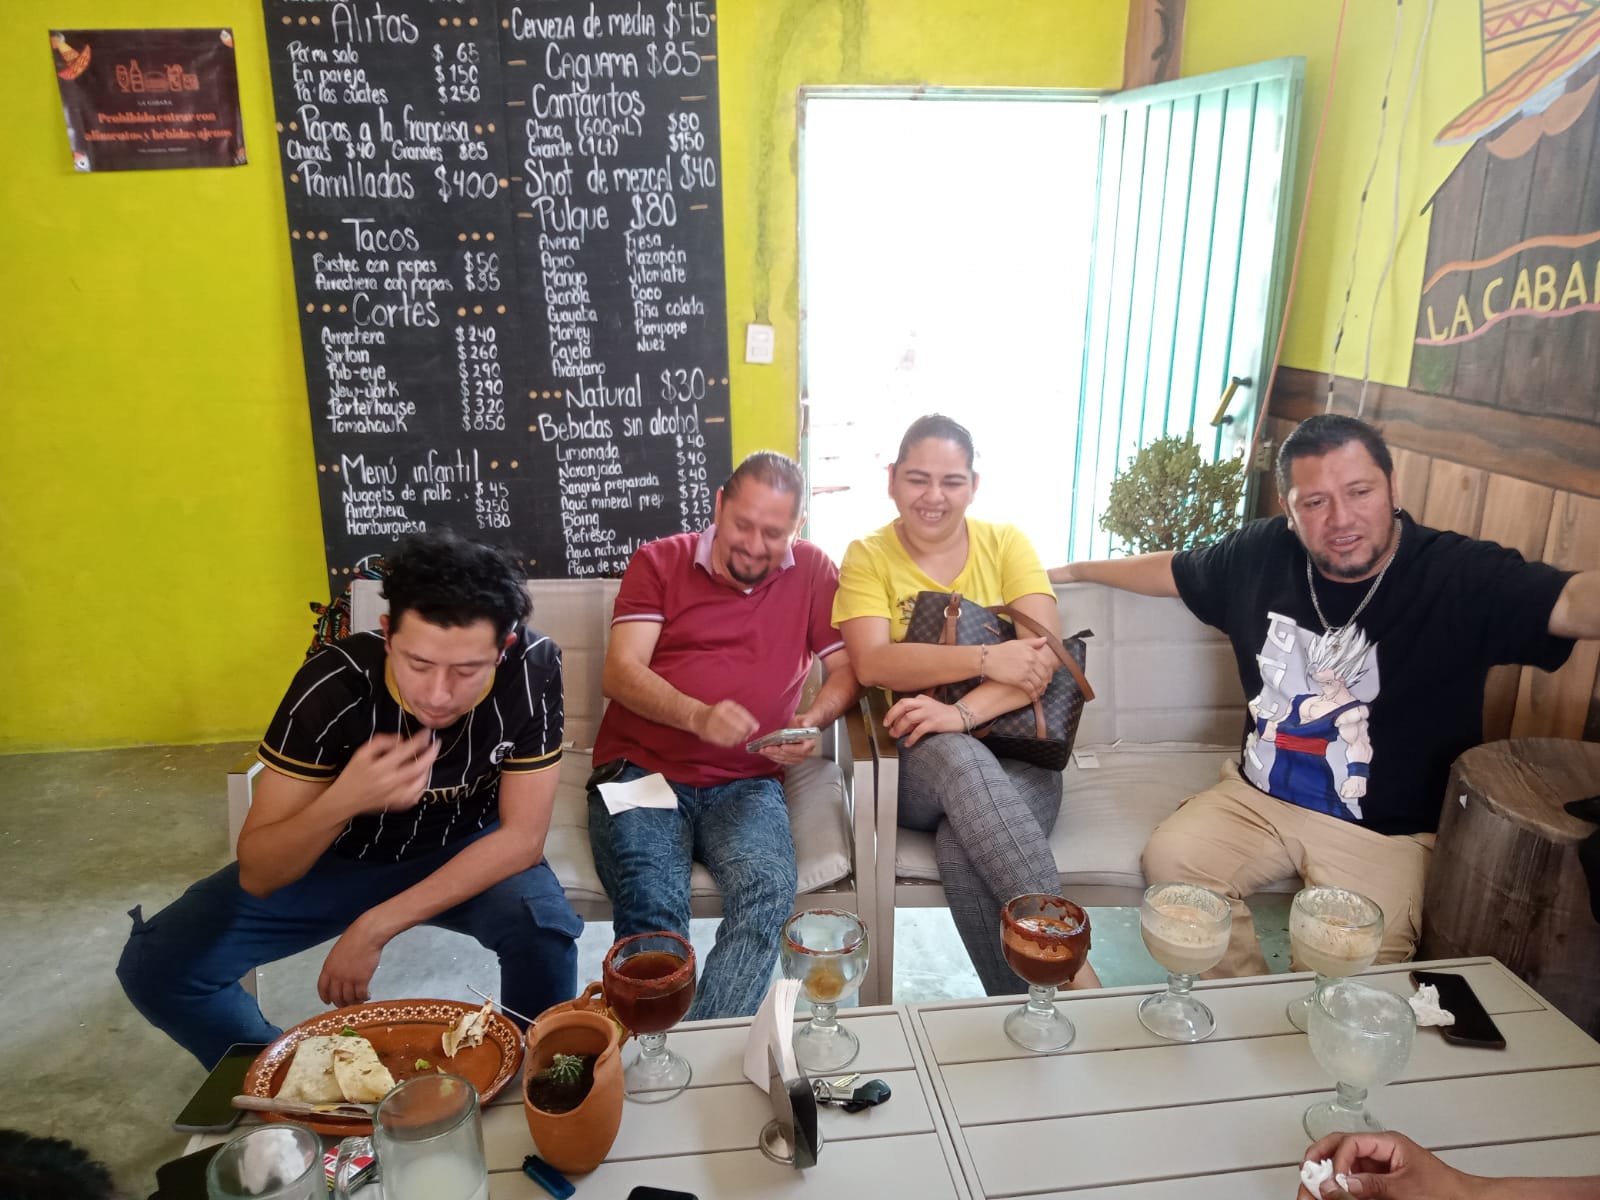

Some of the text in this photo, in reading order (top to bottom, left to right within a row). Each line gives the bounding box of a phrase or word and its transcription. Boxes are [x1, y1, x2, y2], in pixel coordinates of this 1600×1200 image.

[332, 1, 420, 44] Alitas
[583, 2, 603, 39] de
[663, 1, 711, 40] $45
[333, 42, 359, 63] solo
[646, 41, 701, 78] $85
[292, 62, 367, 88] En pareja
[343, 82, 389, 104] cuates
[532, 80, 646, 119] Cantaritos
[98, 111, 156, 123] Prohibido
[296, 104, 352, 149] Papas
[359, 121, 371, 142] a
[378, 106, 394, 142] la
[667, 113, 700, 132] $80
[287, 140, 332, 162] Chicas
[391, 139, 444, 162] Grandes
[528, 137, 574, 158] Grande
[668, 131, 705, 152] $150
[434, 164, 499, 203] $400
[525, 158, 574, 198] Shot
[587, 155, 609, 194] de
[680, 152, 716, 192] $40
[531, 193, 678, 243] Pulque $80
[341, 218, 420, 253] Tacos
[539, 233, 581, 250] Avena
[624, 230, 662, 250] Fresa
[313, 252, 437, 280] Bistec con papas
[541, 252, 576, 269] Apio
[384, 277, 407, 291] con
[411, 278, 454, 300] papas
[543, 270, 588, 290] Mango
[631, 284, 662, 301] Coco
[1427, 259, 1600, 341] LA CABA
[352, 291, 441, 328] Cortes
[547, 305, 599, 328] Guayaba
[666, 296, 705, 316] colada
[321, 326, 386, 345] Arrachera
[549, 325, 591, 344] Mamey
[637, 337, 666, 352] Nuez
[325, 344, 370, 364] Sirloin
[327, 362, 387, 386] Rib-eye
[566, 366, 706, 408] Natural $30
[327, 397, 416, 416] Porterhouse
[538, 403, 699, 442] Bebidas sin alcohol
[556, 440, 620, 462] Limonada
[341, 448, 479, 485] Menú infantil
[558, 462, 623, 481] Naranjada
[342, 482, 452, 506] Nuggets de pollo
[605, 473, 660, 496] preparada
[561, 497, 588, 516] Agua
[592, 492, 633, 510] mineral
[346, 519, 427, 542] Hamburguesa
[561, 512, 600, 533] Boing
[563, 528, 616, 544] Refresco
[594, 538, 633, 558] natural
[598, 556, 609, 571] de
